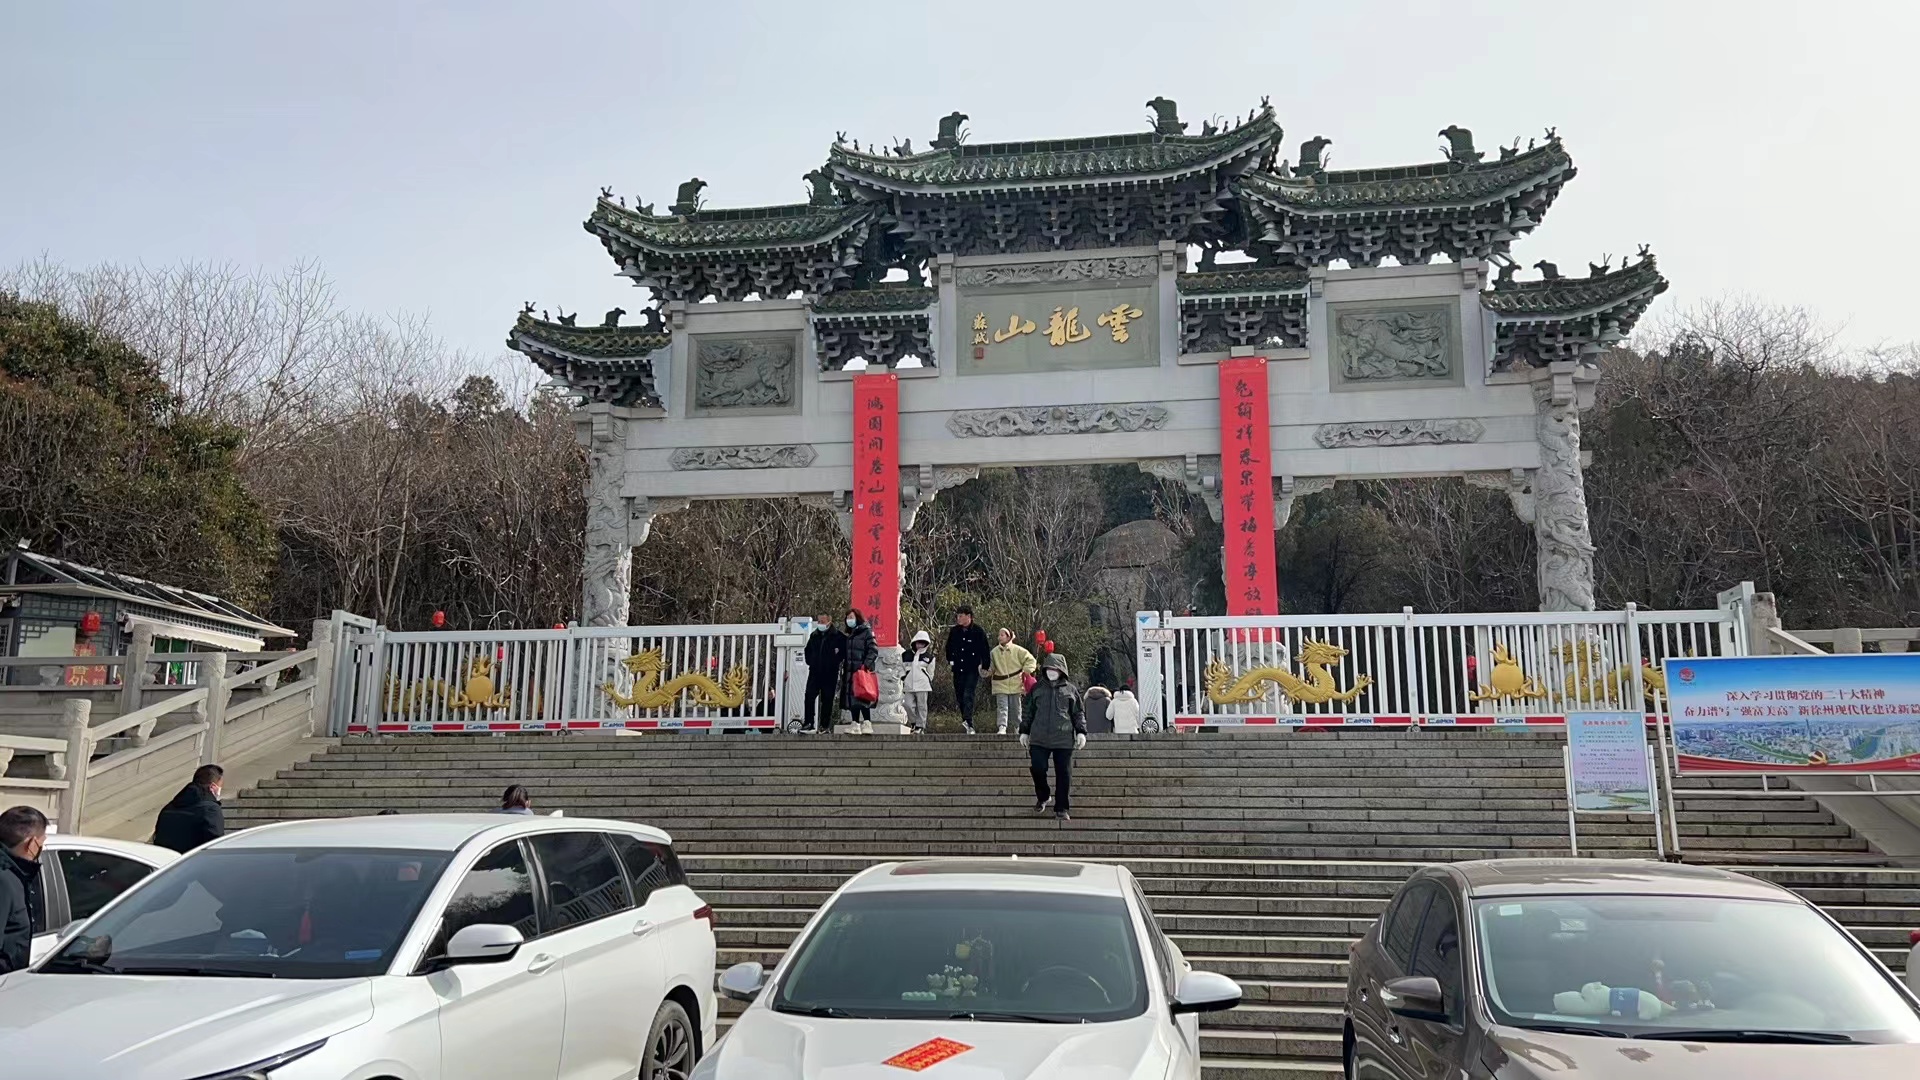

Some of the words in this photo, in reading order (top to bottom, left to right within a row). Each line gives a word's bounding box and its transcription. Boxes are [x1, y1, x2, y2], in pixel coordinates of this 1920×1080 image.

[1726, 689, 1885, 701] 深入学习贯彻党的二十大精神
